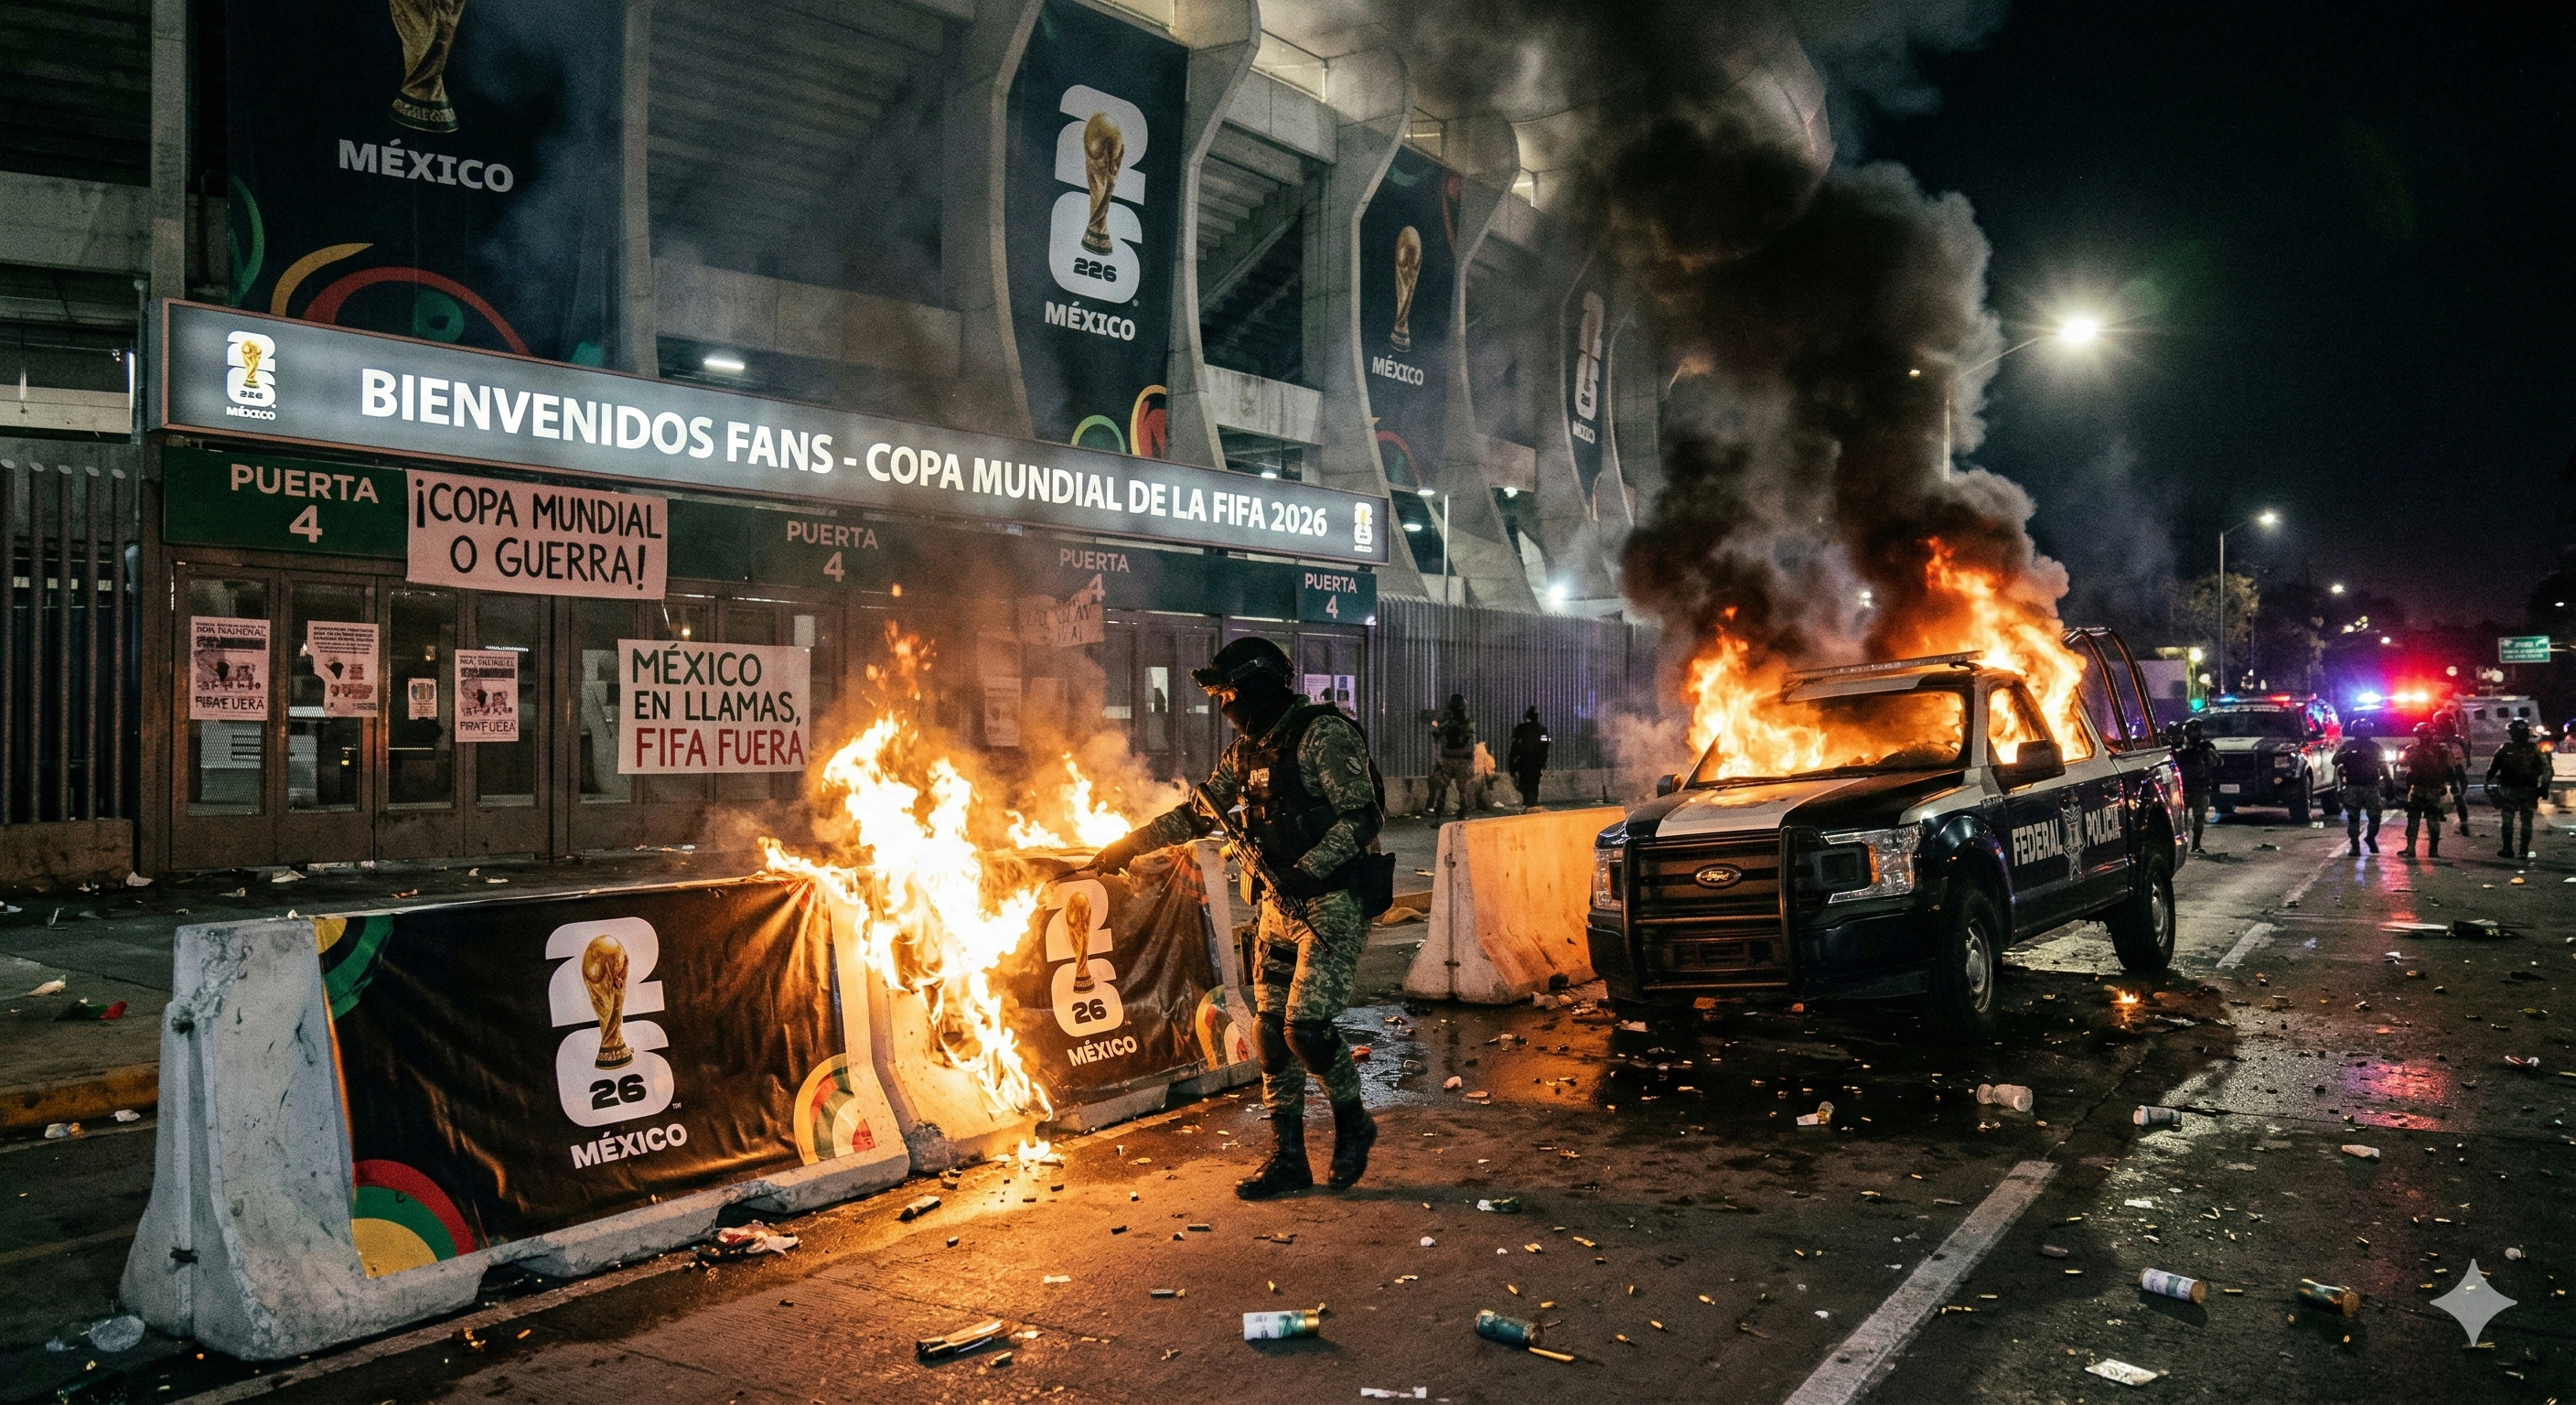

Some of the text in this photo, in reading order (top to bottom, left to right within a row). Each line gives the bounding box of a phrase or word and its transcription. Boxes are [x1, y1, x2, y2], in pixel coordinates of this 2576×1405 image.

[339, 138, 513, 192] MÉXICO
[1073, 257, 1117, 283] 226
[1045, 301, 1135, 340] MÉXICO
[1372, 355, 1423, 386] MÉXICO
[362, 368, 714, 459] BIENVENIDOS
[727, 421, 834, 474] FANS
[866, 443, 964, 491] COPA
[972, 457, 1122, 511] MUNDIAL
[1129, 479, 1166, 517] DE
[1173, 486, 1207, 521] LA
[1213, 491, 1266, 530] FIFA
[1271, 501, 1327, 537] 2026
[231, 464, 379, 504] PUERTA
[289, 505, 323, 543] 4
[415, 478, 661, 539] ¡COPA MUNDIAL
[787, 520, 878, 550] PUERTA
[449, 535, 646, 591] O GUERRA!
[823, 551, 845, 583] 4
[1060, 548, 1130, 574] PUERTA
[1086, 573, 1106, 602] 4
[1304, 573, 1358, 594] PUERTA
[1326, 595, 1338, 618] 4
[633, 643, 762, 687] MÉXICO
[635, 691, 801, 727] EN LLAMAS,
[637, 727, 805, 767] FIFA FUERA
[2012, 819, 2064, 866] FEDERAL
[1072, 998, 1107, 1025] 26
[1067, 1035, 1138, 1067] MÉXICO
[589, 1074, 647, 1110] 26
[571, 1123, 688, 1169] MÉXICO
